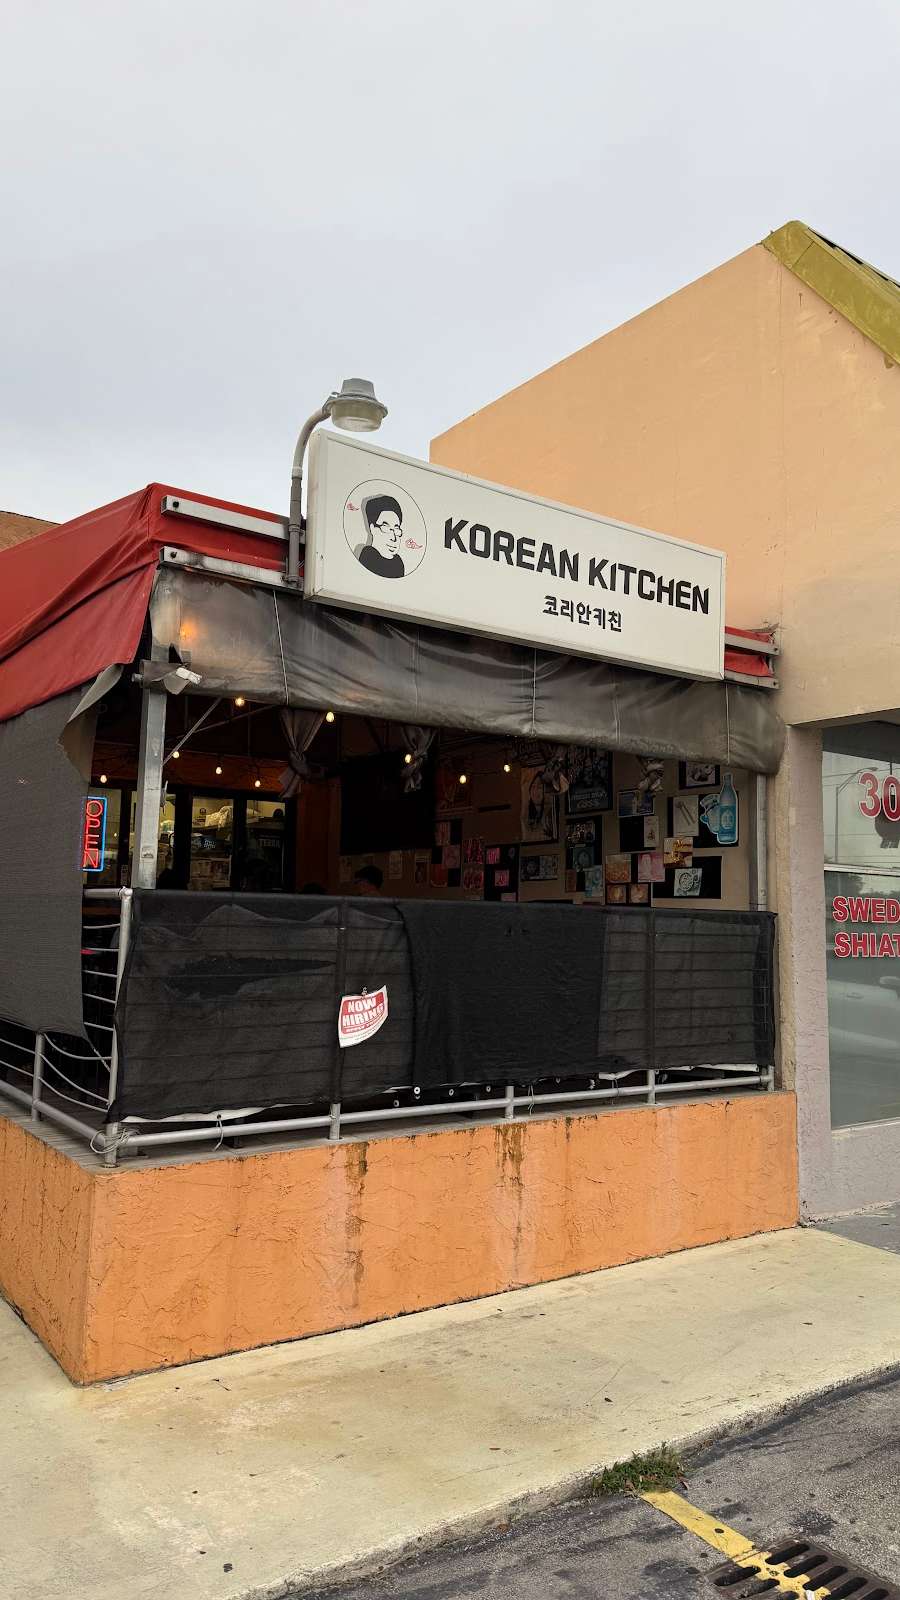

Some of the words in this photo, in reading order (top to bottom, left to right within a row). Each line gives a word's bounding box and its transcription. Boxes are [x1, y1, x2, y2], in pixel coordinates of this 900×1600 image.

[444, 517, 580, 582] KOREAN
[588, 557, 710, 615] KITCHEN
[542, 595, 623, 633] 코리안키친
[83, 800, 103, 868] OPEN
[342, 1003, 385, 1027] HIRING
[347, 998, 377, 1012] NOW
